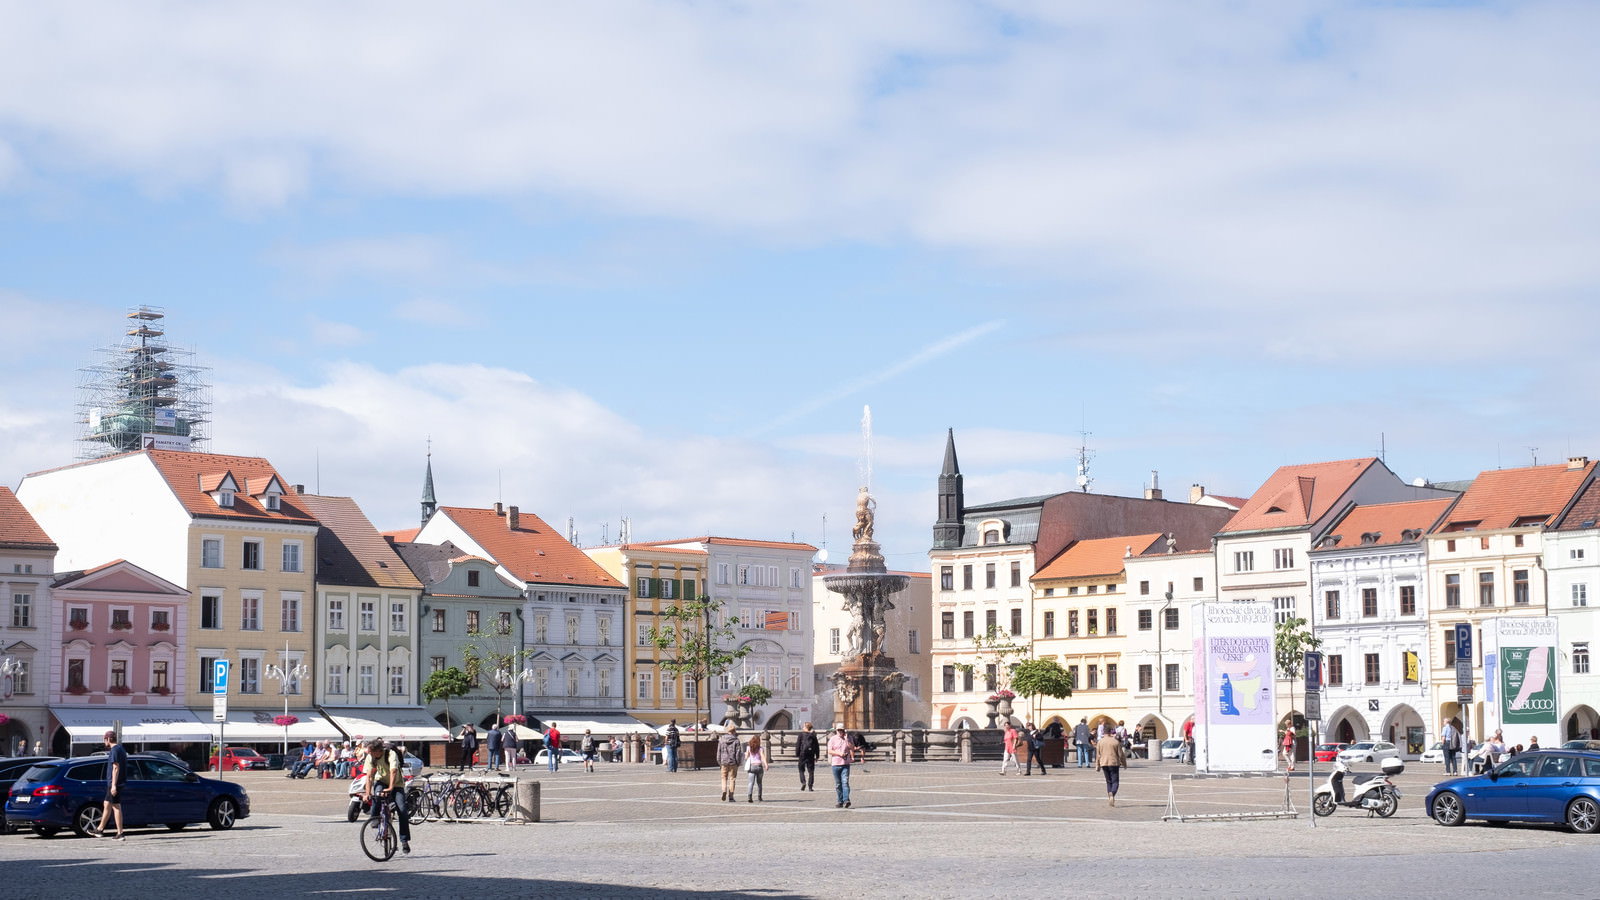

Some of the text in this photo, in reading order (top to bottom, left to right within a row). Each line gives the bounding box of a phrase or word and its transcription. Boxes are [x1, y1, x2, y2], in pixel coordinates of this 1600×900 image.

[1243, 605, 1271, 615] divadlo
[1230, 638, 1242, 646] DO
[1242, 638, 1269, 646] EGYPTA
[1459, 628, 1469, 649] P
[216, 664, 226, 684] P
[1308, 656, 1317, 679] P
[1508, 698, 1553, 710] NBUCCO
